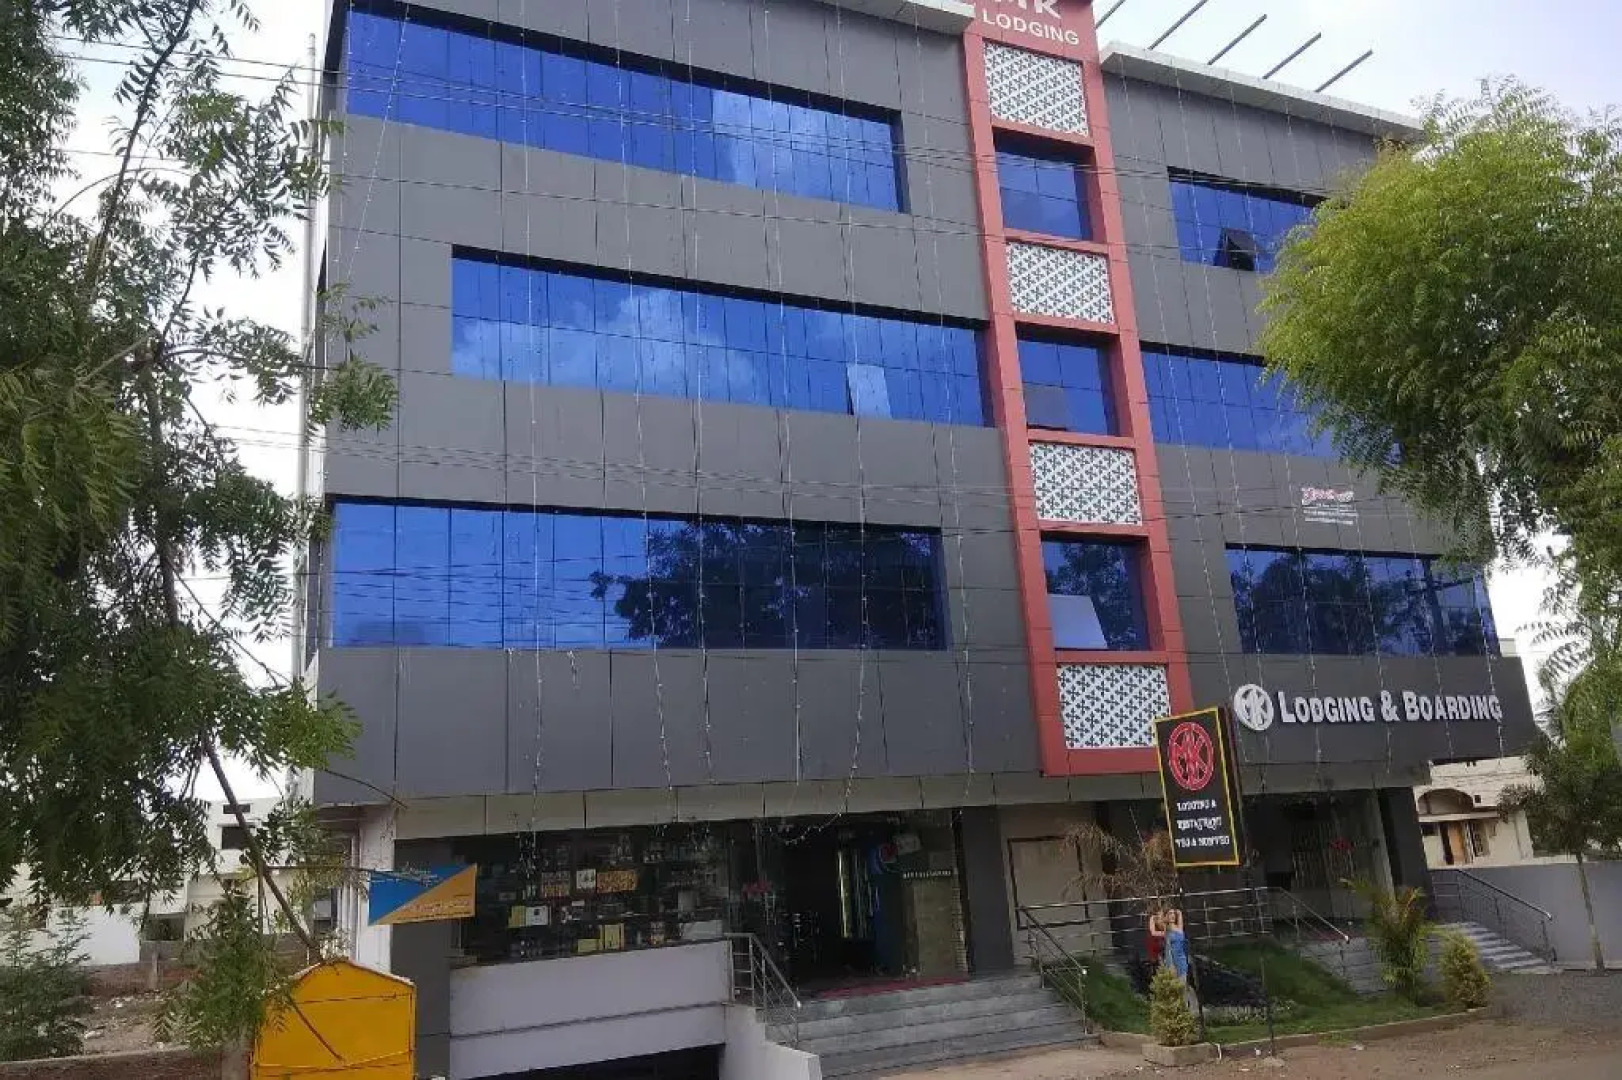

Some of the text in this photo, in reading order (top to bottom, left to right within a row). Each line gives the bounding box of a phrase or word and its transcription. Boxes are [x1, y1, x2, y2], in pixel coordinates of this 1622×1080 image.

[982, 8, 1080, 45] LODGING
[1278, 691, 1375, 723] LODGING
[1381, 690, 1400, 721] &
